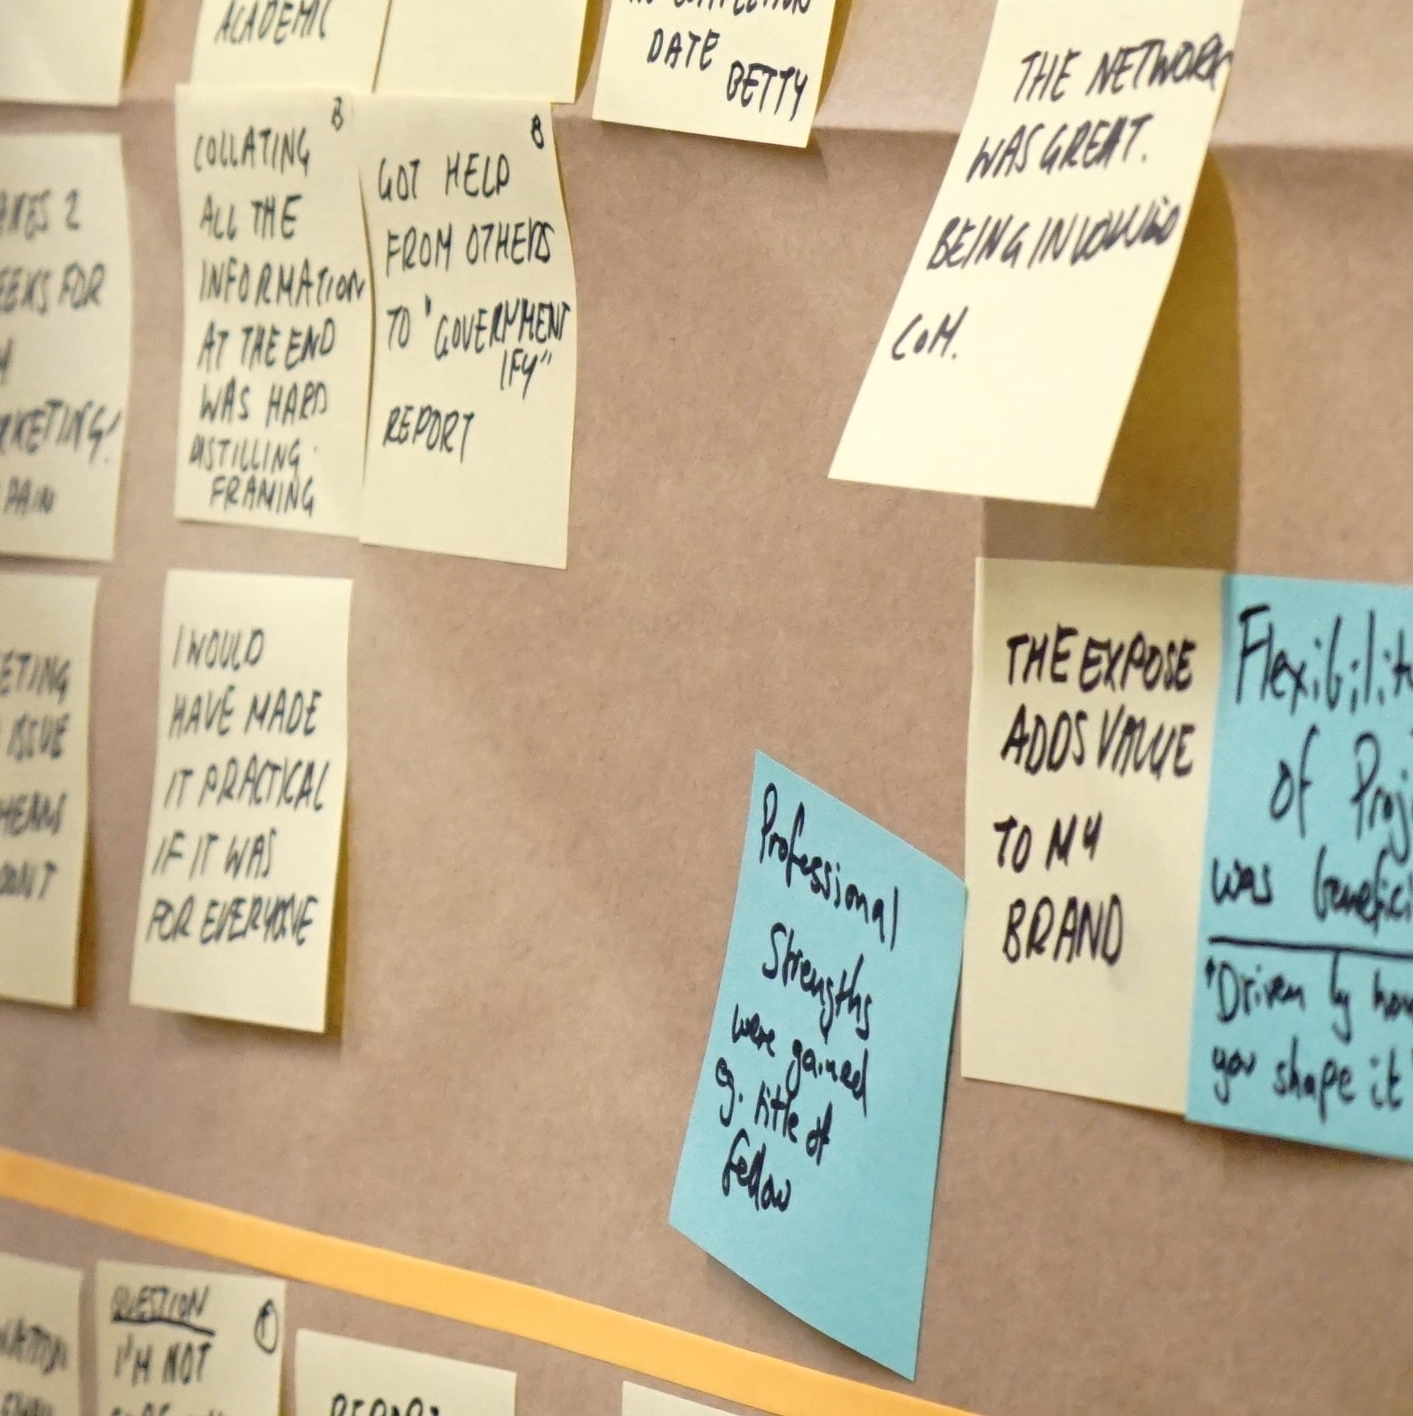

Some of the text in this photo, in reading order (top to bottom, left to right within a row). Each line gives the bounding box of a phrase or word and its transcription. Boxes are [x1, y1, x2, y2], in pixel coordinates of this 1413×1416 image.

[646, 26, 720, 72] DATE
[1012, 47, 1082, 104] THE
[725, 59, 809, 123] BETTY
[194, 125, 310, 178] COLLATING
[377, 157, 420, 202] GOT
[965, 121, 1046, 184] WAS
[63, 187, 81, 232] 2
[200, 192, 303, 241] ALL THE
[385, 216, 554, 278] FROM OTHERS
[925, 214, 1030, 271] BEING
[57, 260, 106, 312] FOR
[198, 257, 365, 307] INFORMATION
[196, 316, 337, 373] AT THE END
[387, 306, 412, 351] TO
[198, 375, 250, 427] WAS
[382, 405, 475, 464] REPORT
[209, 475, 315, 518] FRAMING
[172, 624, 265, 672] I WOULD
[1005, 621, 1197, 694] THE EXPOSE
[1235, 603, 1413, 716] Flexibilit
[168, 686, 322, 740] HAVE MADE
[1000, 703, 1196, 779] ADDS VALUE
[163, 753, 331, 813] IT PRACTICAL
[1270, 723, 1320, 839] of
[151, 827, 277, 880] IF IT WAS
[759, 782, 899, 952] Professional
[993, 811, 1104, 873] TO MY
[1211, 856, 1273, 906] was
[146, 893, 319, 947] FOR EVERYONE
[1003, 893, 1124, 965] BRAND
[761, 922, 872, 1045] Strengths
[1330, 950, 1352, 1046] by
[731, 1003, 869, 1118] were gained
[1212, 1045, 1257, 1106] you
[1273, 1035, 1356, 1124] shape
[805, 1101, 833, 1166] of
[162, 1341, 212, 1386] NOT
